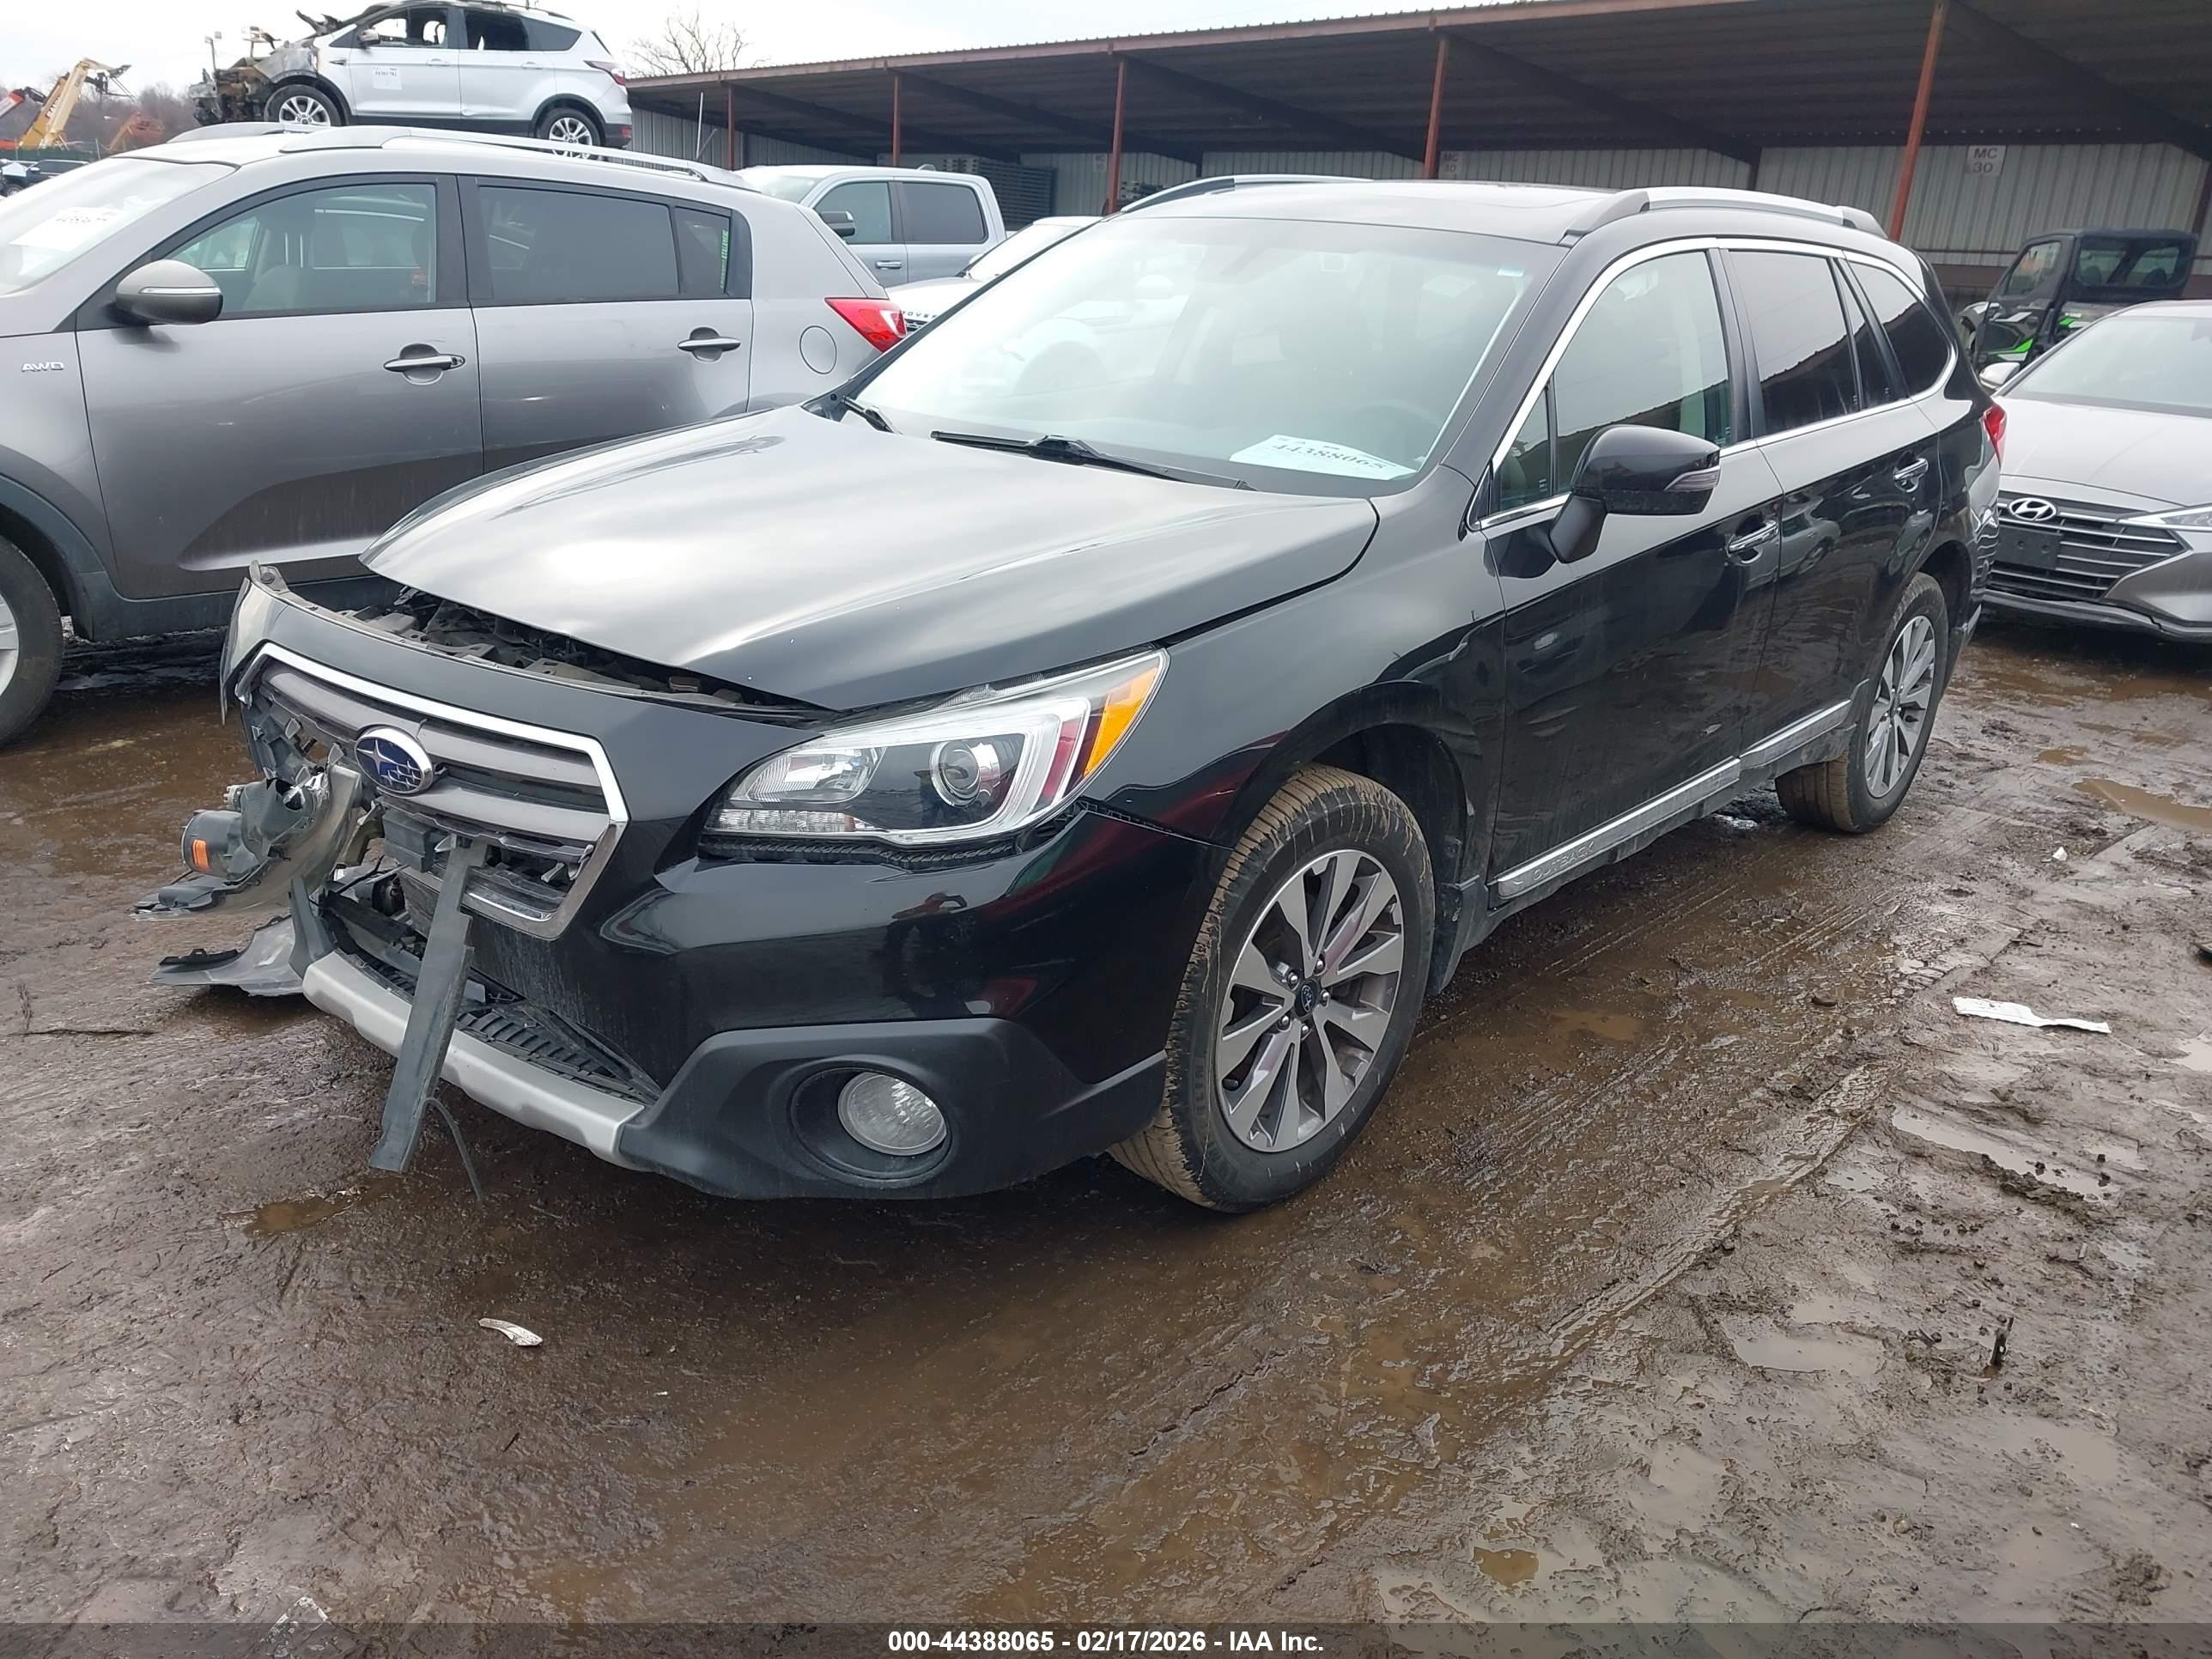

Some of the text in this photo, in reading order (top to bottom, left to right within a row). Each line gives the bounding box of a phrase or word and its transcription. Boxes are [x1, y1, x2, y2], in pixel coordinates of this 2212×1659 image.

[1973, 147, 1998, 159] MC
[1972, 162, 1993, 173] 30
[21, 362, 64, 372] AWD
[1532, 841, 1595, 881] OUTBACK
